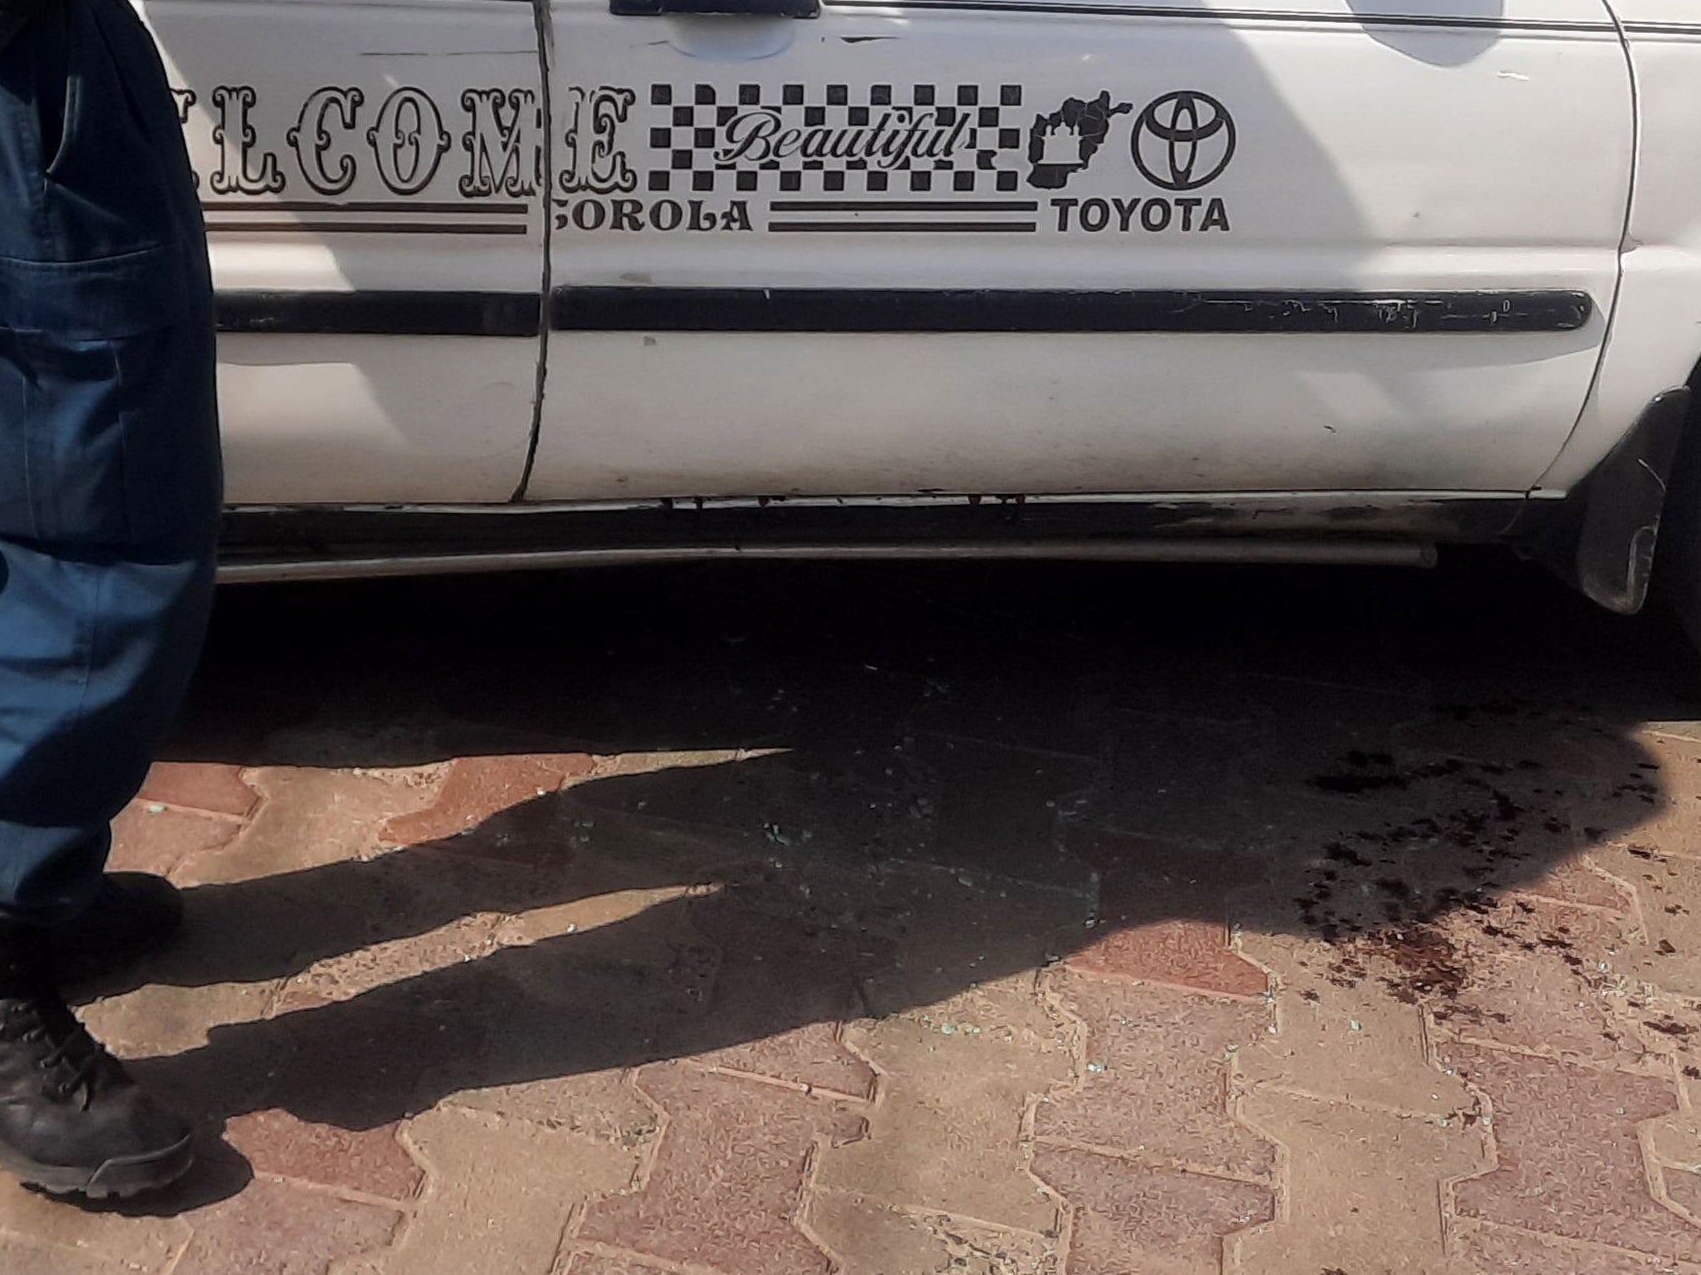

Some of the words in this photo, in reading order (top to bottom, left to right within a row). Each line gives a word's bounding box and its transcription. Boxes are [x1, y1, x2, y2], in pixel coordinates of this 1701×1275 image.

[169, 84, 637, 198] LCOME
[713, 111, 972, 170] Beautiful
[1051, 197, 1230, 232] TOYOTA
